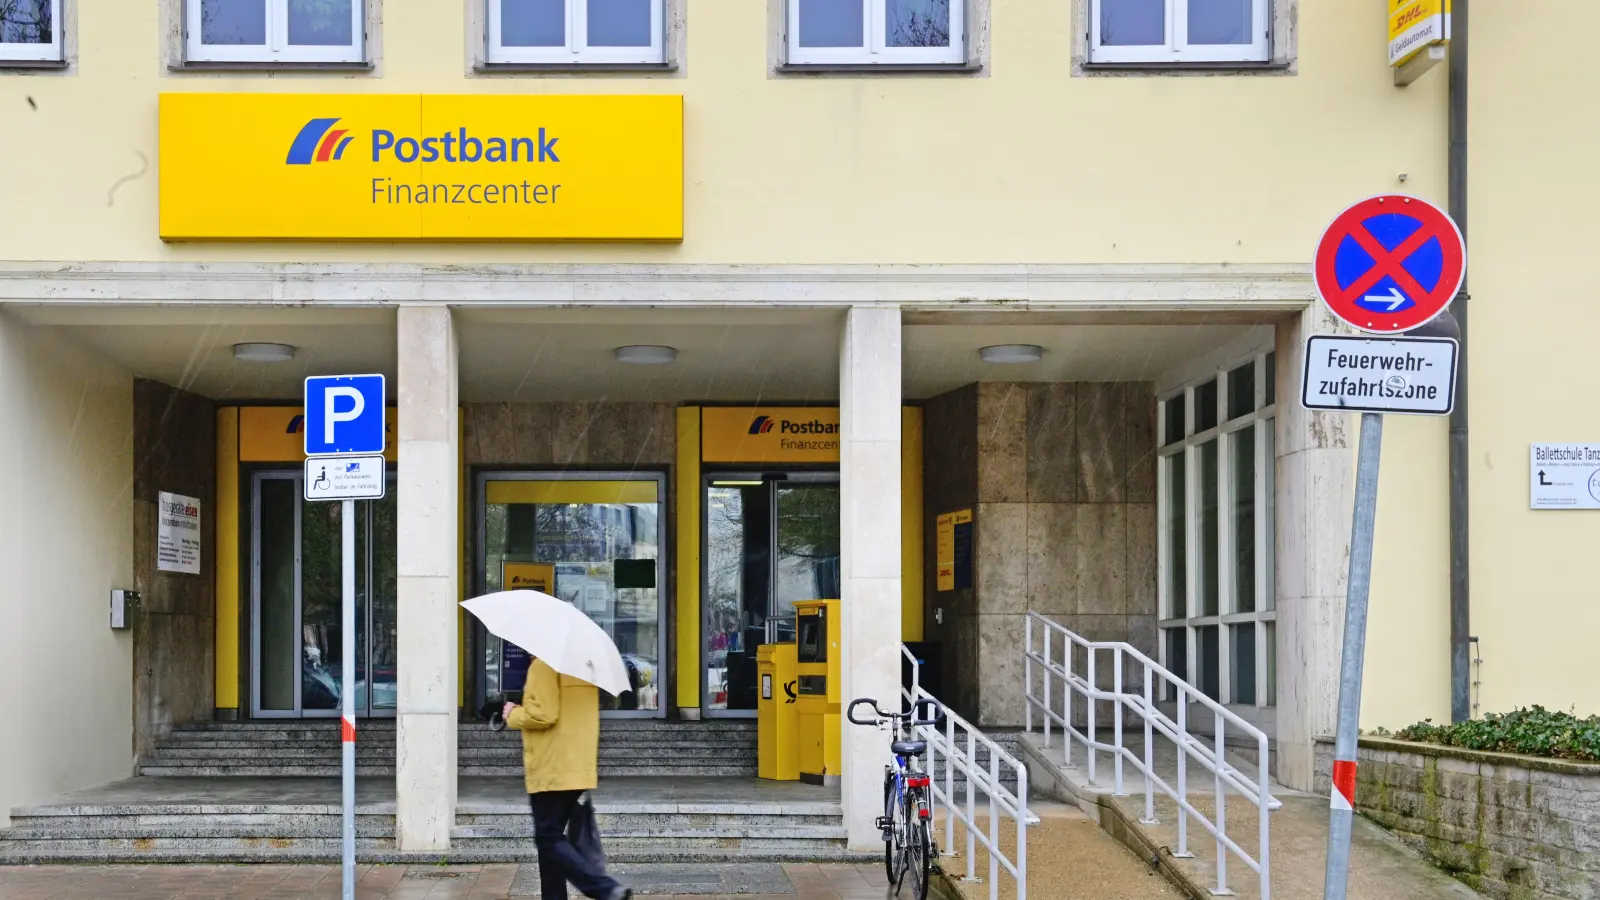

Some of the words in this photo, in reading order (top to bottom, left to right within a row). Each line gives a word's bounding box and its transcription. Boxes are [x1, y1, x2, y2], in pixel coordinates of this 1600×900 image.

[1396, 4, 1423, 30] DHL
[1395, 24, 1432, 53] Geldautomat
[371, 127, 561, 162] Postbank
[372, 177, 562, 204] Finanzcenter
[1327, 348, 1434, 372] Feuerwehr-
[324, 386, 365, 444] P
[781, 439, 840, 450] Finanzcen
[1536, 446, 1582, 460] Ballettschule
